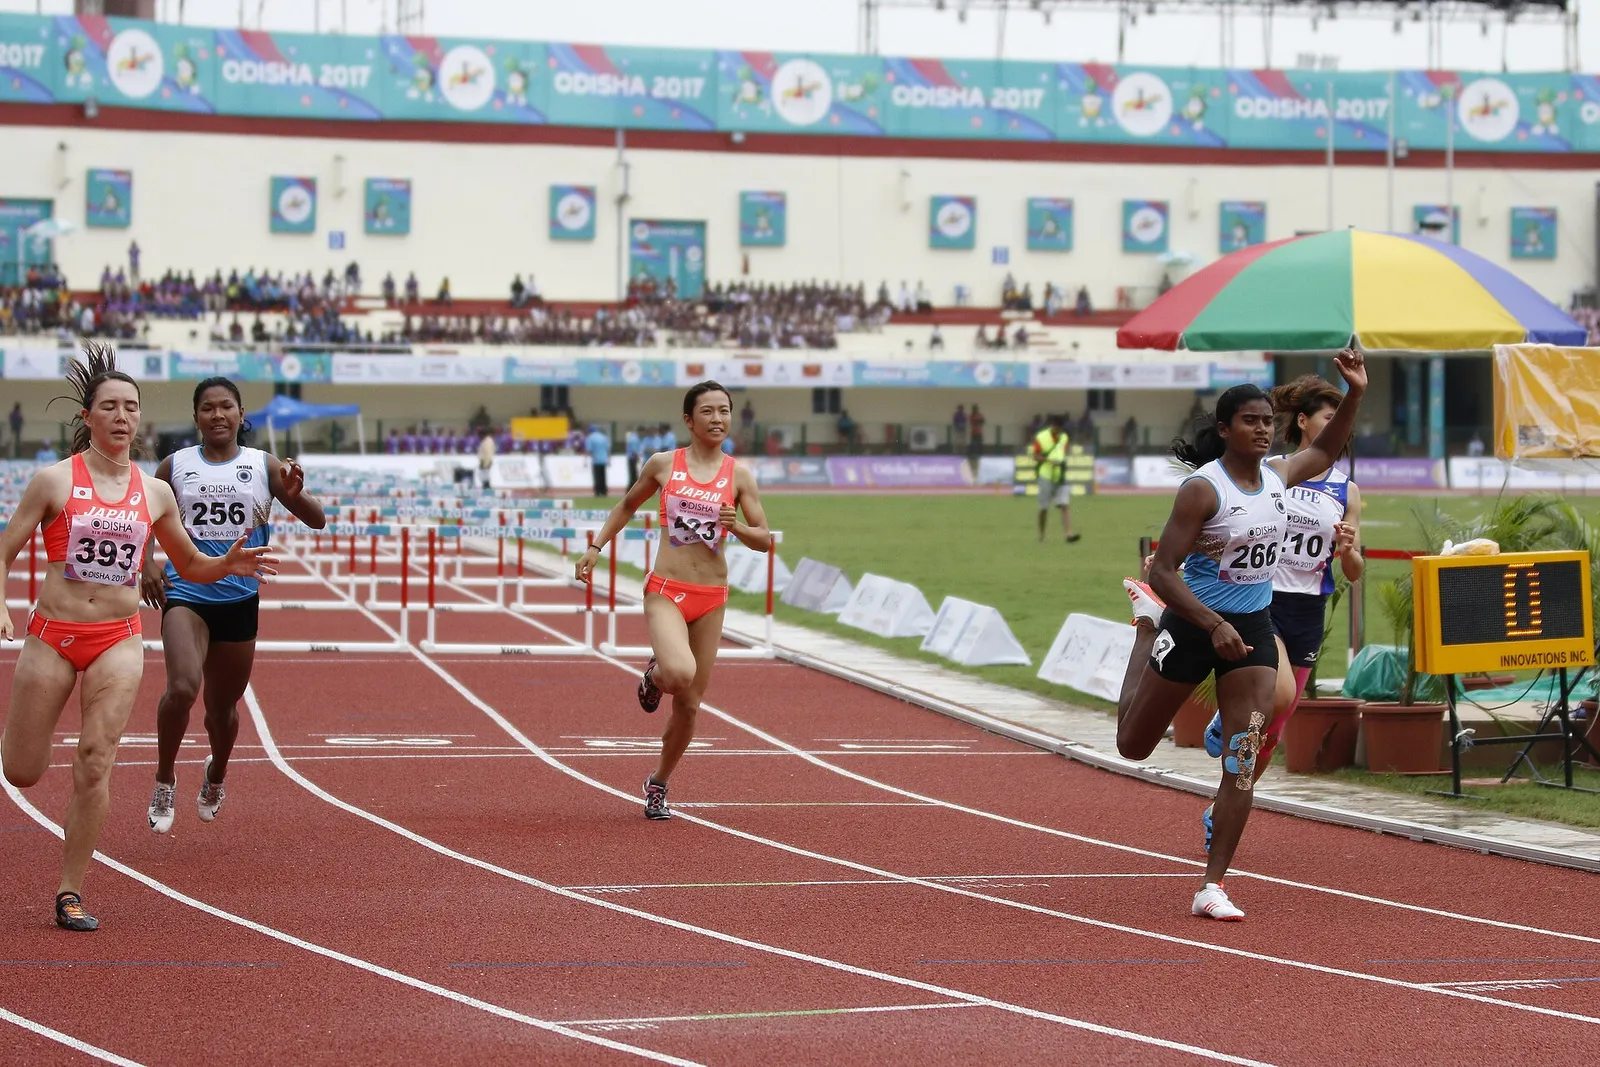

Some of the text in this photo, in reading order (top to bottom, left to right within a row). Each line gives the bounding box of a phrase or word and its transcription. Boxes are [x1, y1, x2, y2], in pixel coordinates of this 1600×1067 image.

[222, 60, 371, 88] ODISHA 2017
[554, 72, 705, 98] ODISHA 2017
[892, 85, 1045, 109] ODISHA 2017
[1235, 97, 1389, 119] ODISHA 2017
[198, 484, 237, 494] ODISHA
[676, 486, 722, 503] JAPAN
[1291, 488, 1321, 503] TPE
[83, 506, 139, 521] JAPAN
[191, 502, 246, 526] 256
[680, 500, 714, 513] ODISHA
[541, 509, 587, 520] ODISHA
[91, 518, 133, 533] ODISHA
[336, 524, 369, 536] 2017
[460, 526, 554, 539] ODISHA 2017
[1247, 525, 1277, 538] ODISHA
[226, 530, 240, 538] 2017
[75, 538, 137, 571] 393
[1229, 542, 1278, 570] 266
[1301, 562, 1315, 570] 2017
[81, 569, 126, 582] ODISHA 2017
[1500, 650, 1589, 667] INNOVATIONS INC.
